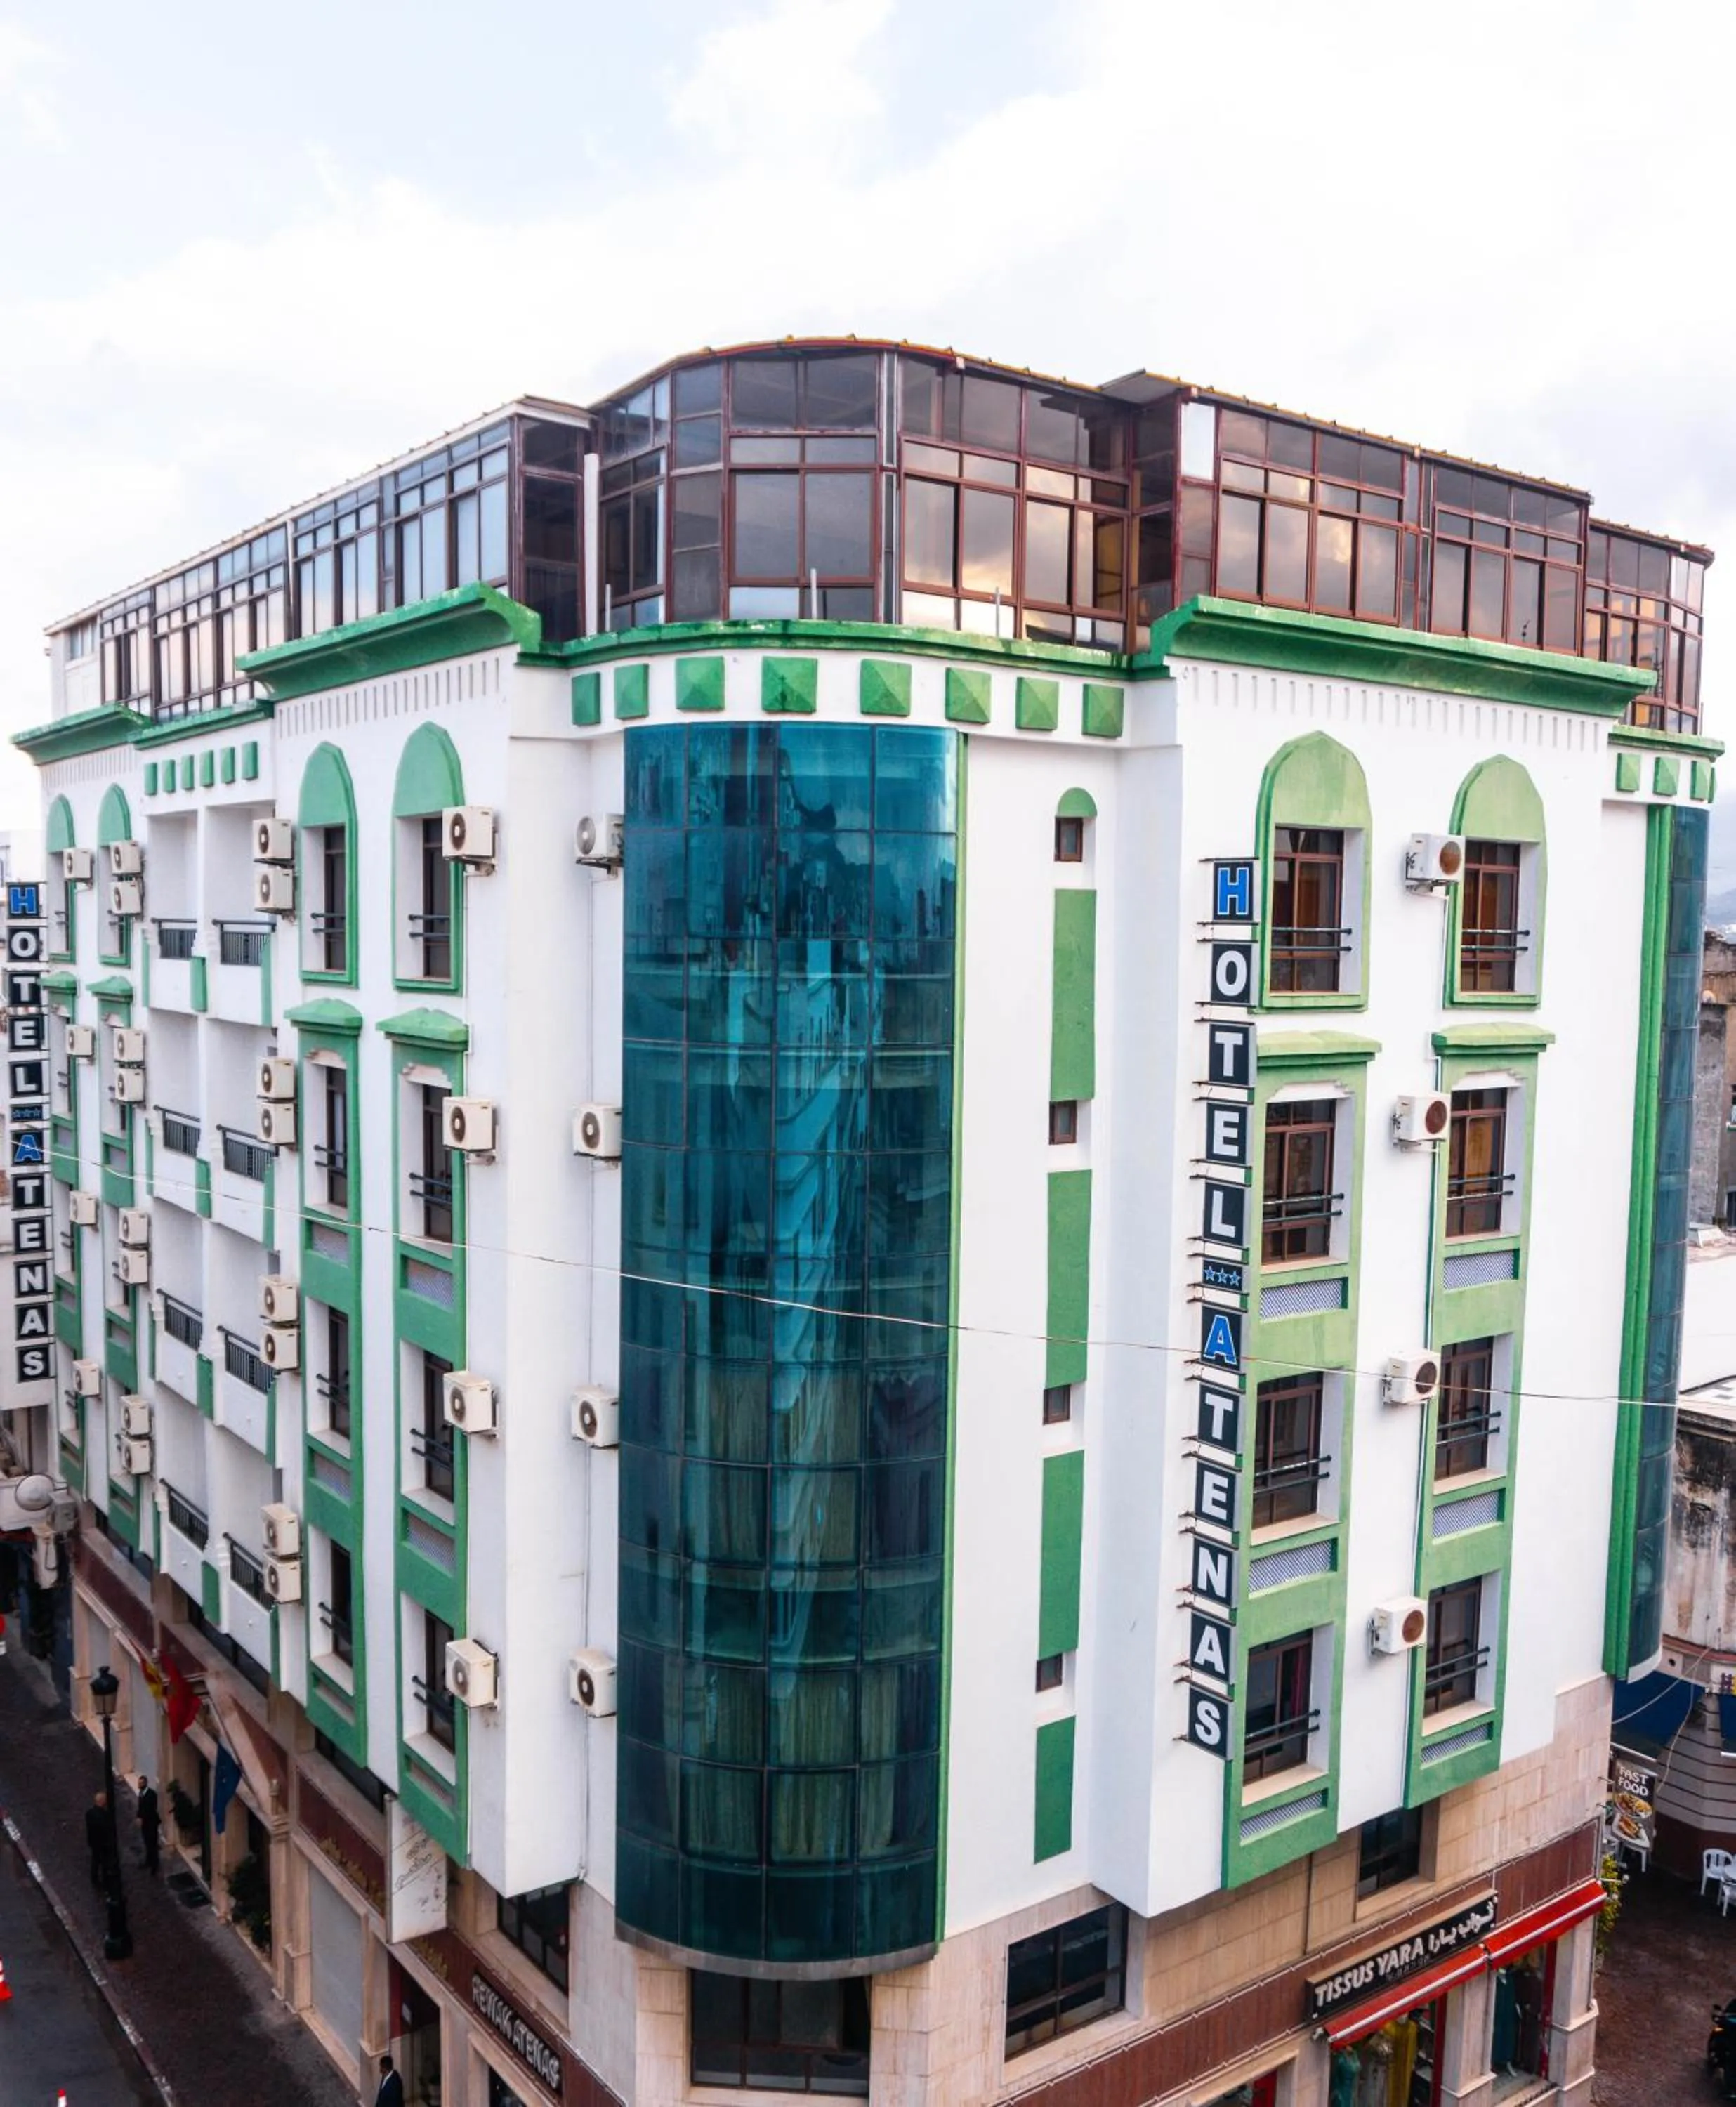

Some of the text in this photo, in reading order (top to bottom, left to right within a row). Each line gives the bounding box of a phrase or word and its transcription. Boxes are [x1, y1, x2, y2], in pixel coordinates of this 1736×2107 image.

[10, 887, 46, 1376] HOTEL ATENAS
[1194, 867, 1249, 1746] HOTEL ATENAS
[1618, 1776, 1648, 1796] FOOD
[1619, 1766, 1649, 1784] FAST
[1315, 1961, 1374, 2007] TISSUS
[1376, 1938, 1423, 1975] YARA
[513, 2019, 560, 2089] ATENAS
